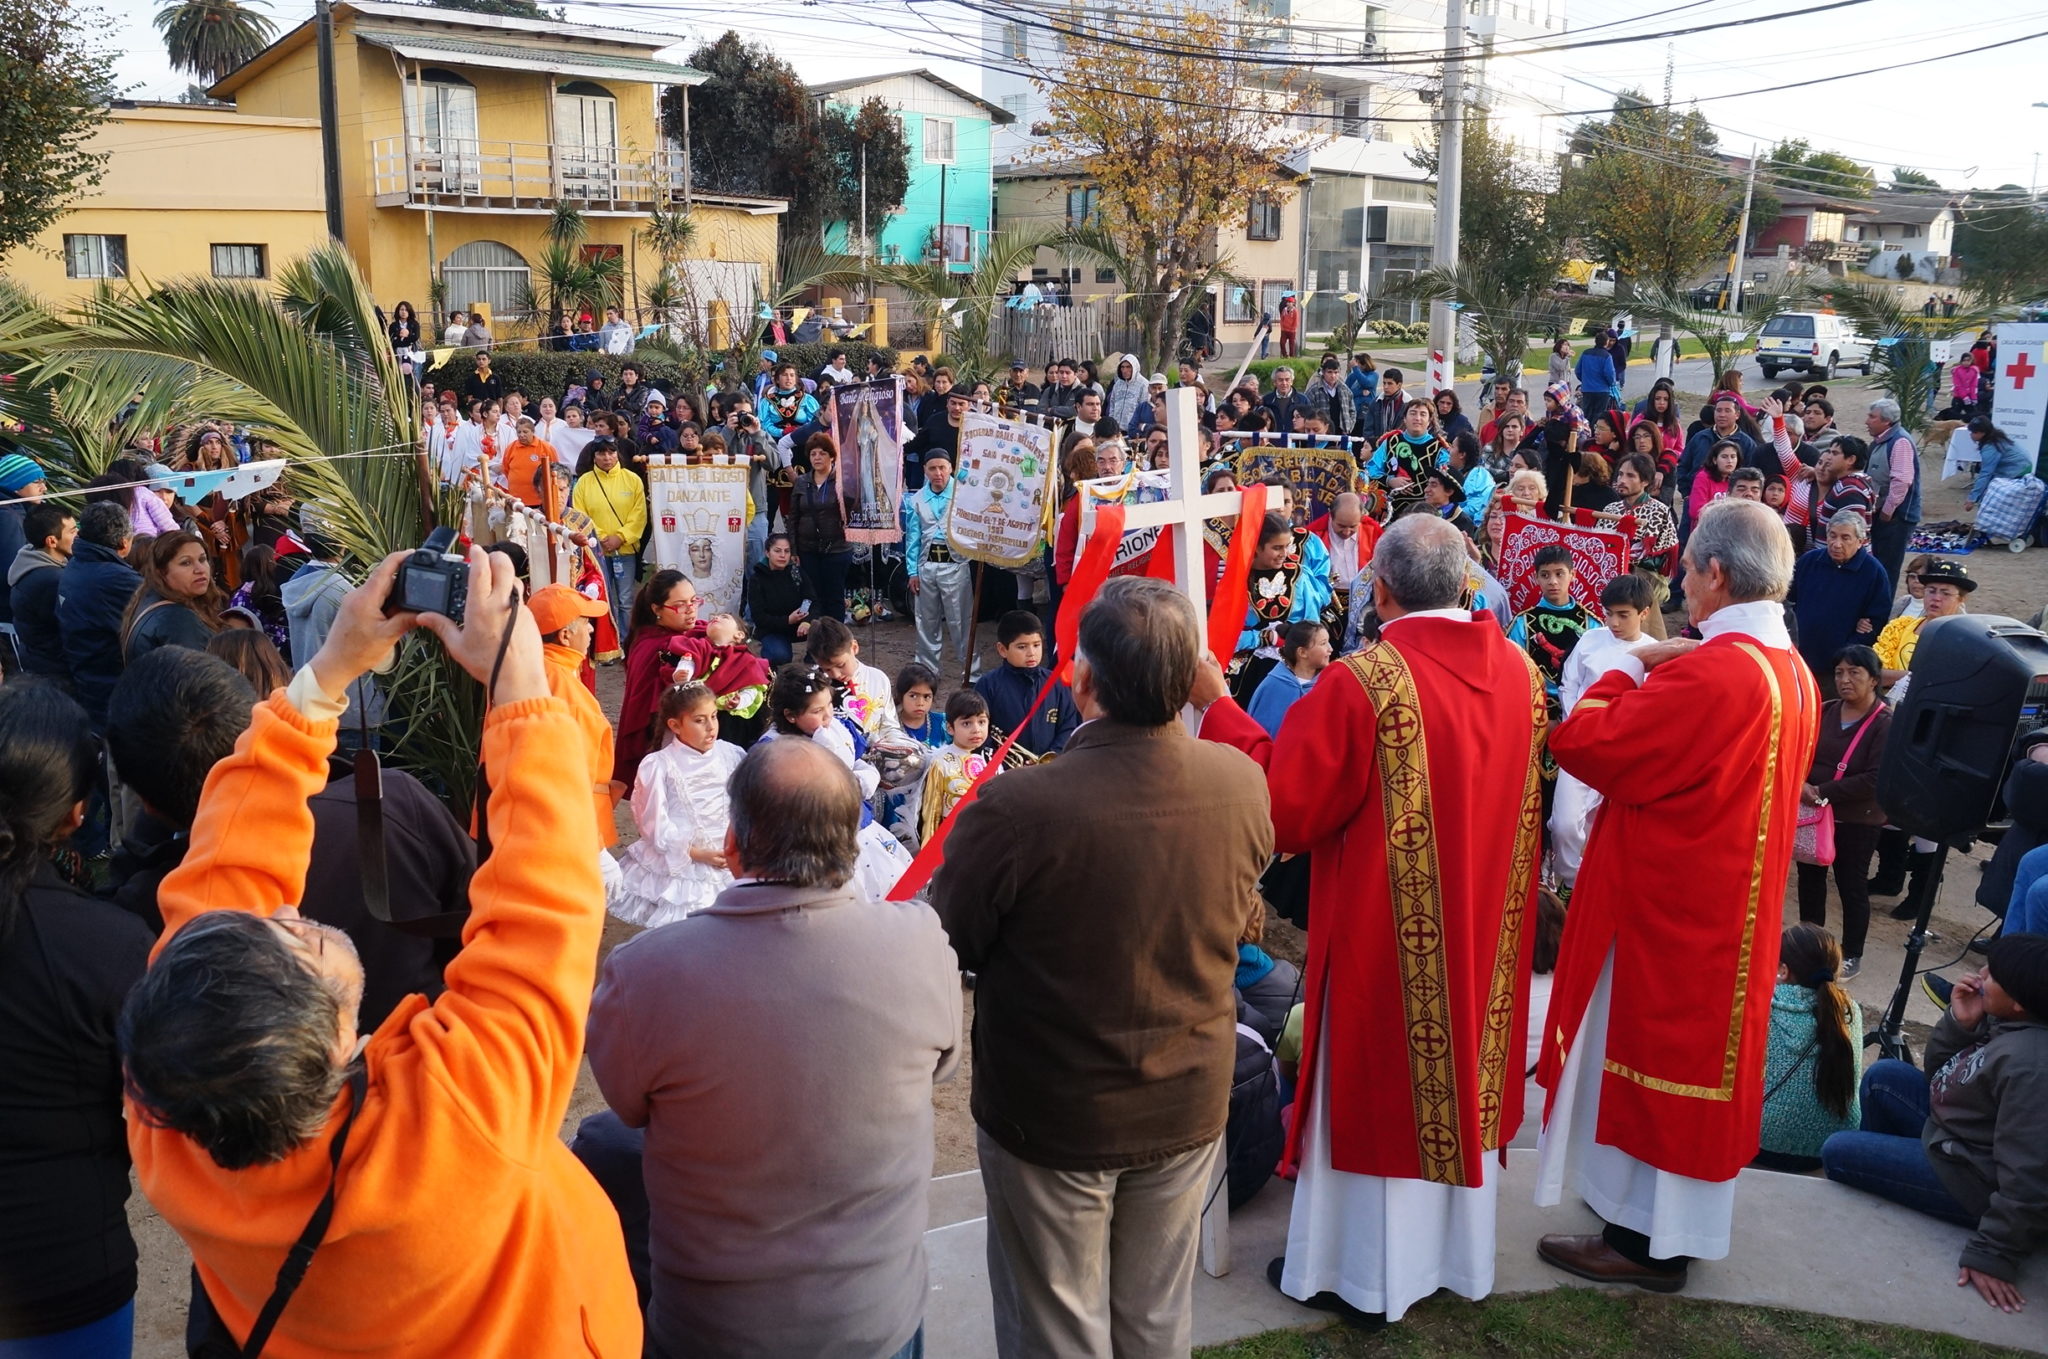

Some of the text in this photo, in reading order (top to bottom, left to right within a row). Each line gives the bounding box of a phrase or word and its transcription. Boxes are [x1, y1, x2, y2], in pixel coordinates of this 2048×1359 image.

[839, 389, 857, 404] Baile
[651, 468, 745, 484] BAILE RELIGIOSO
[667, 489, 731, 502] DANZANTE
